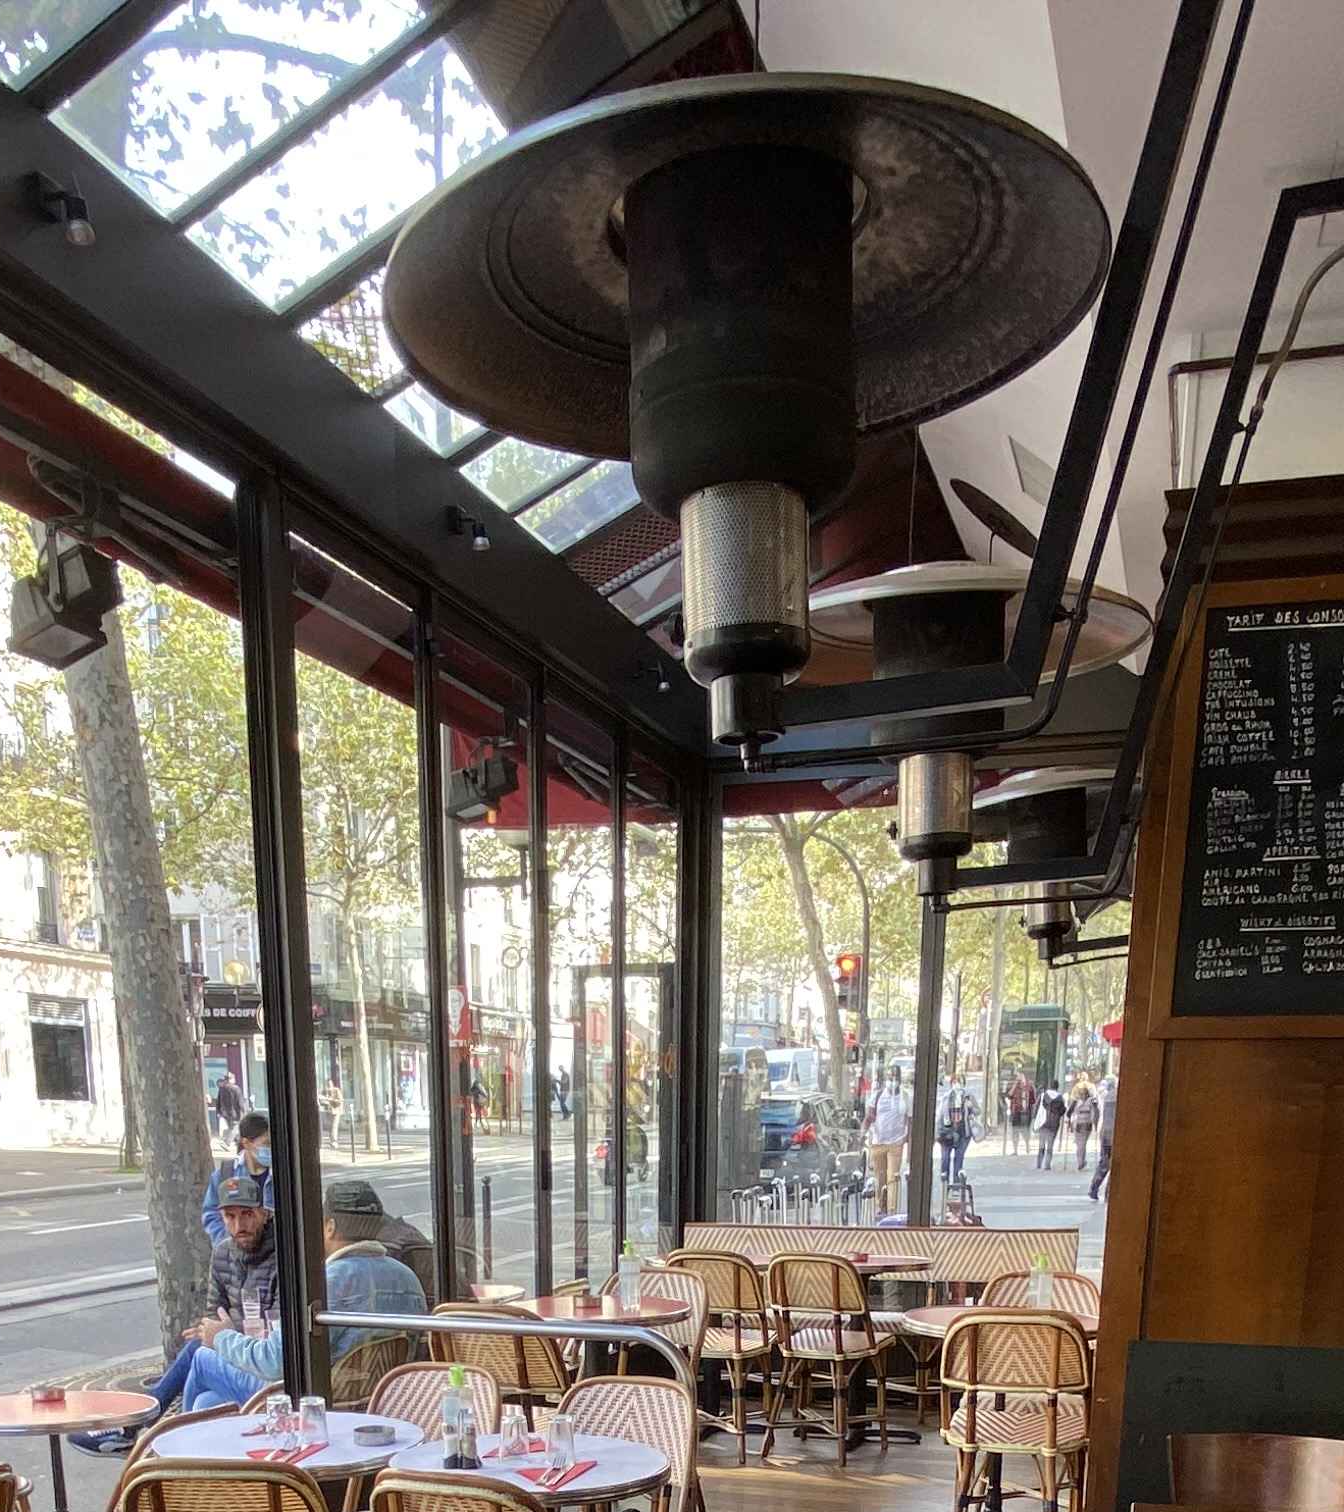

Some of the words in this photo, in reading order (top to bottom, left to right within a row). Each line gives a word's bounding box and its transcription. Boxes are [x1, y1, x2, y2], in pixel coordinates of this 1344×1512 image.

[1275, 611, 1300, 624] DES
[212, 1008, 226, 1017] DE
[228, 1008, 257, 1018] COIFF
